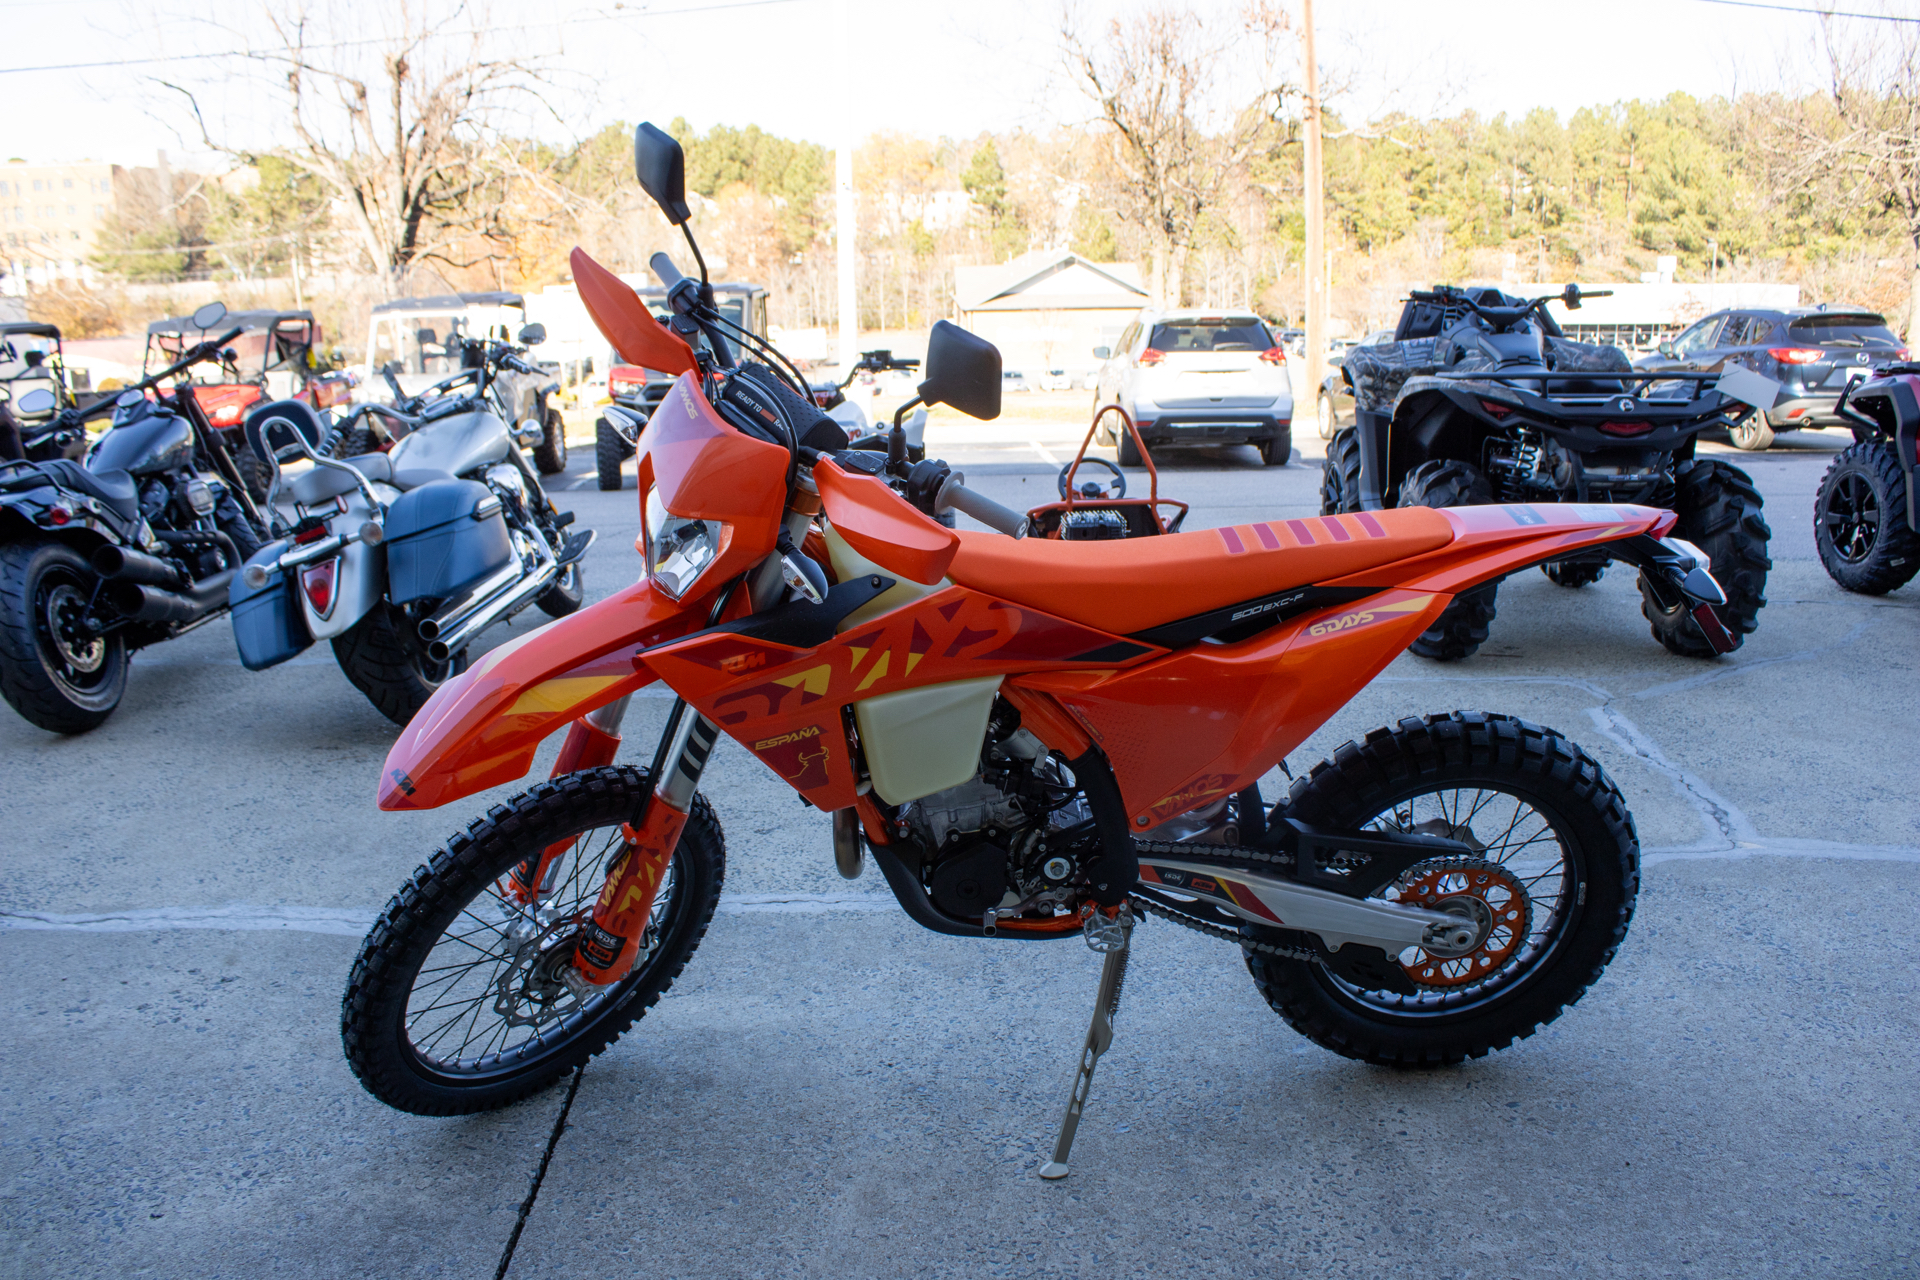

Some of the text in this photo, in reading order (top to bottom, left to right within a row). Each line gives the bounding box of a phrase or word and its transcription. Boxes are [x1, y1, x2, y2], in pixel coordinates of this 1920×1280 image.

[678, 380, 699, 420] VAMOS
[735, 390, 755, 407] READY
[753, 402, 763, 413] TO
[1309, 611, 1375, 637] 6DAYS
[719, 651, 766, 673] KTM
[755, 726, 820, 751] ESPAÑA
[390, 768, 417, 797] KTM
[1156, 774, 1223, 816] VAMOS
